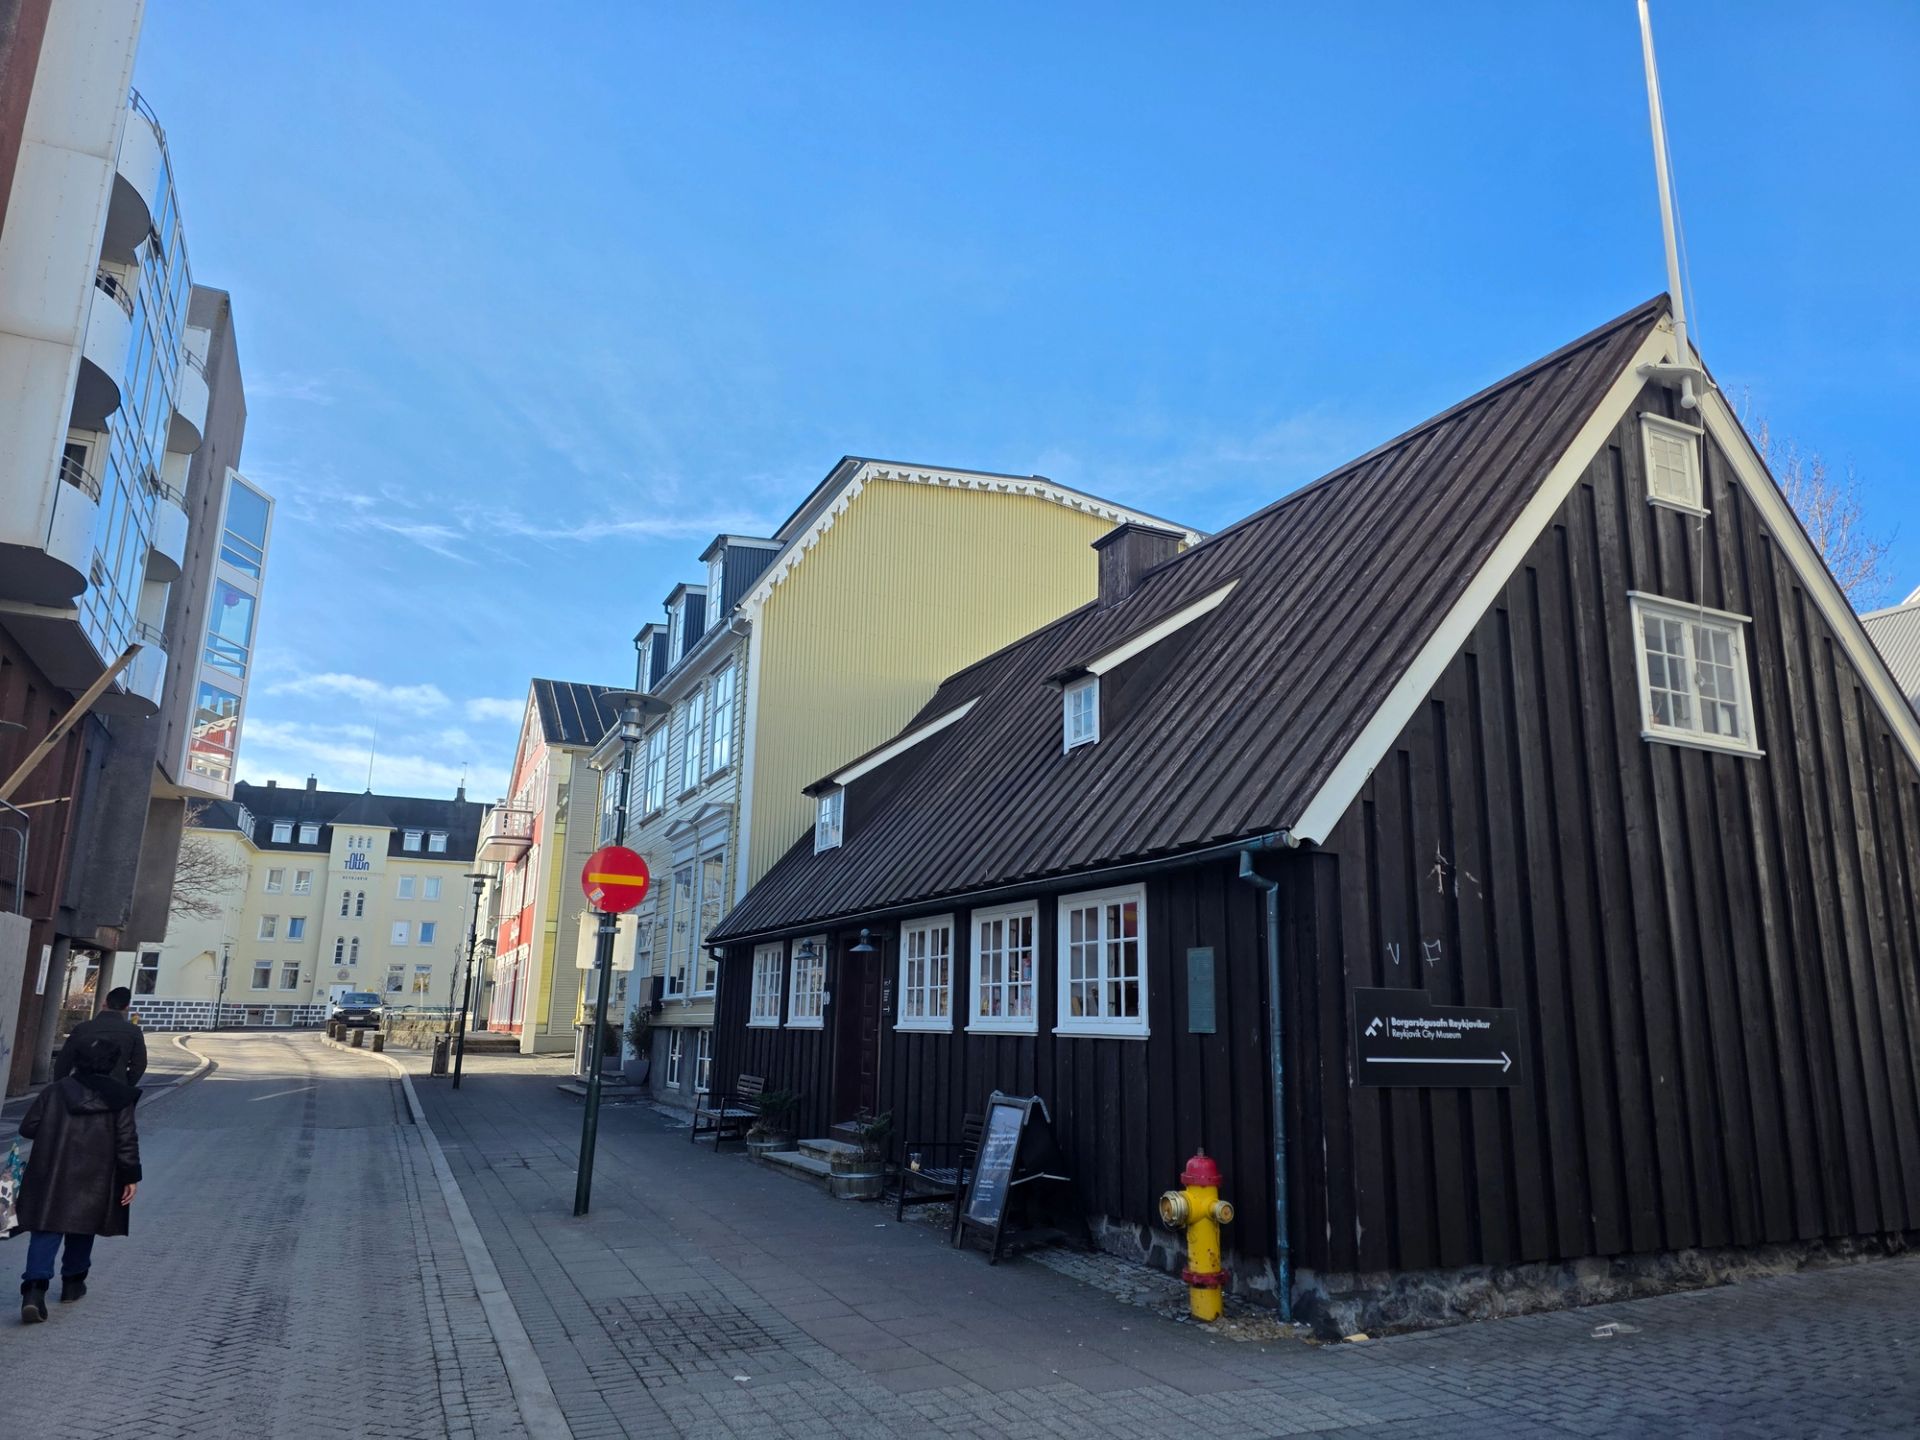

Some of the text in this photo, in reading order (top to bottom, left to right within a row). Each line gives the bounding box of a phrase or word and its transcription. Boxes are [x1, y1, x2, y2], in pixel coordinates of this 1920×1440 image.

[350, 852, 365, 862] OLD
[1391, 1017, 1447, 1029] Borgarsögusafn
[1422, 1029, 1435, 1040] City
[1436, 1030, 1462, 1039] Museum
